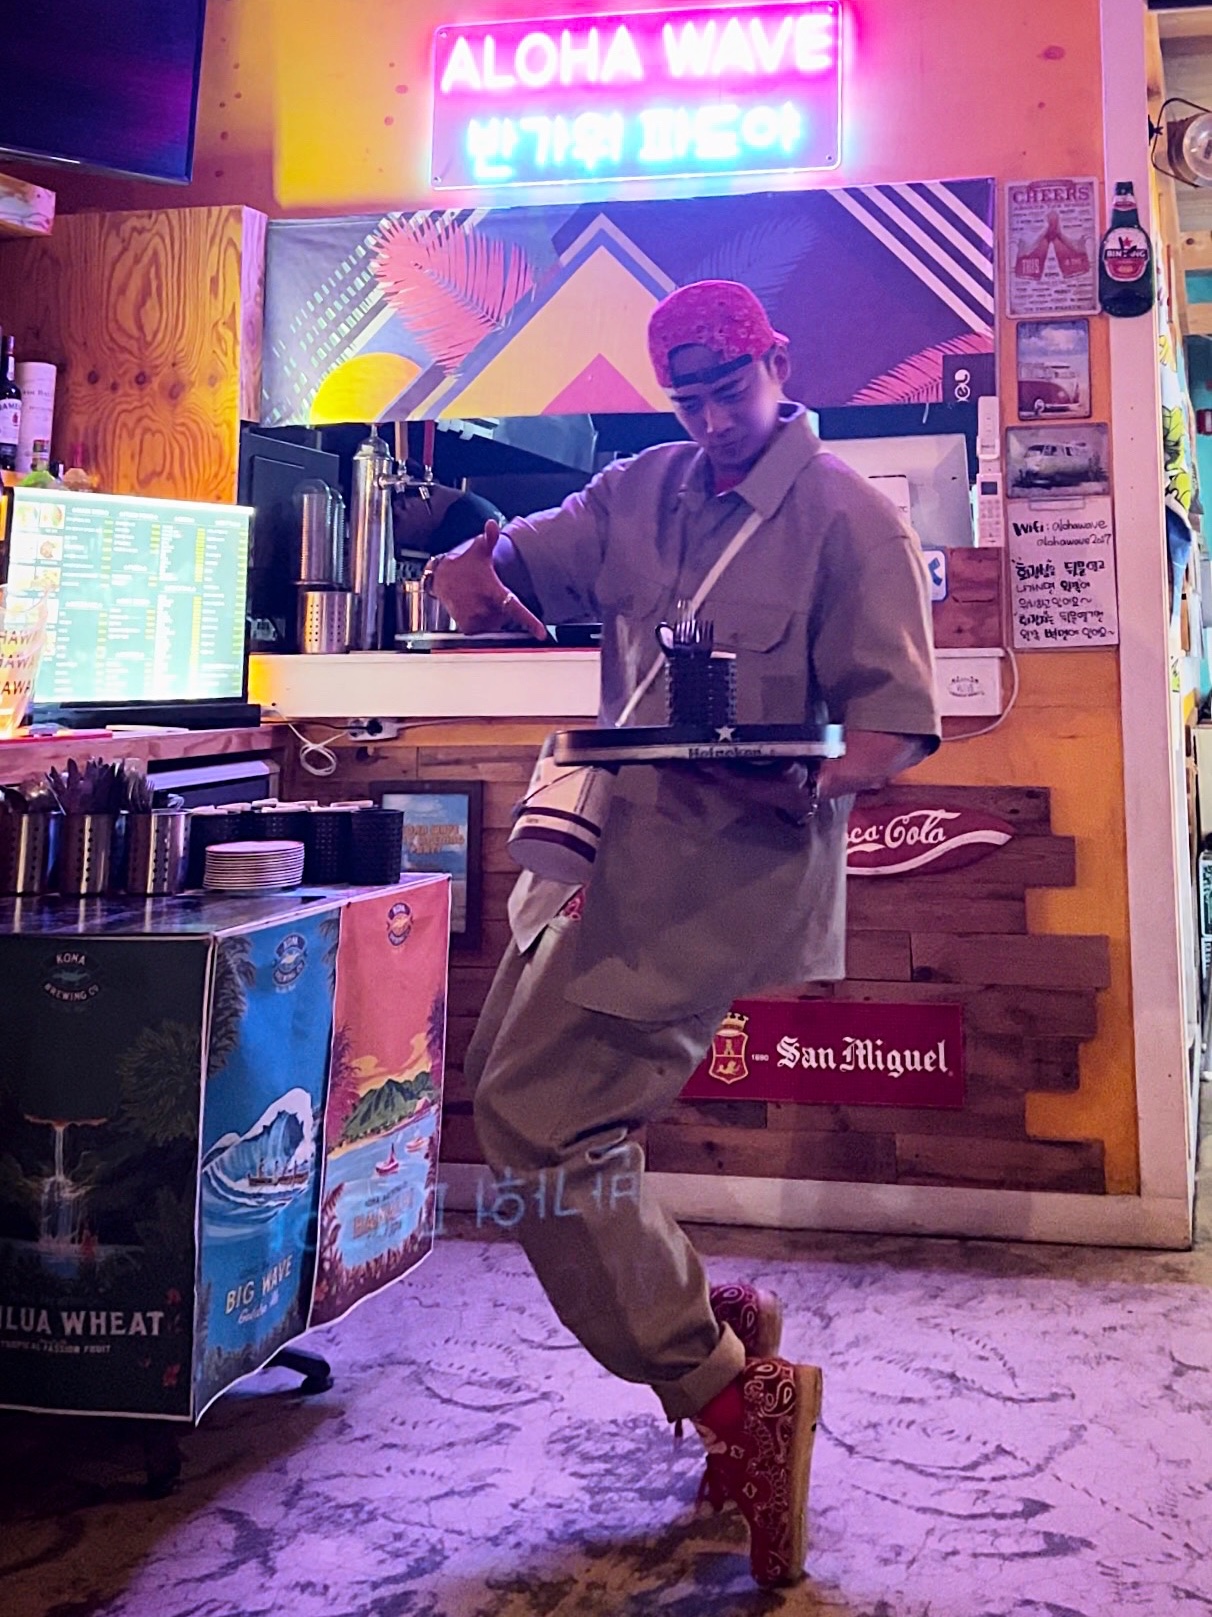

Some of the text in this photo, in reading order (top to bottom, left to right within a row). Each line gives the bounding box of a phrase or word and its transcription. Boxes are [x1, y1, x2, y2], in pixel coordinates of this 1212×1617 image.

[440, 13, 836, 94] ALOHA WAVE
[465, 100, 803, 181] 반가워 파도야
[1013, 187, 1090, 203] CHEERS
[1106, 250, 1146, 258] BINNG
[56, 952, 86, 966] KONA
[776, 1035, 837, 1069] San
[839, 1036, 949, 1078] Miguel
[225, 1253, 294, 1315] BIG WAVE
[60, 1310, 164, 1336] WHEAT
